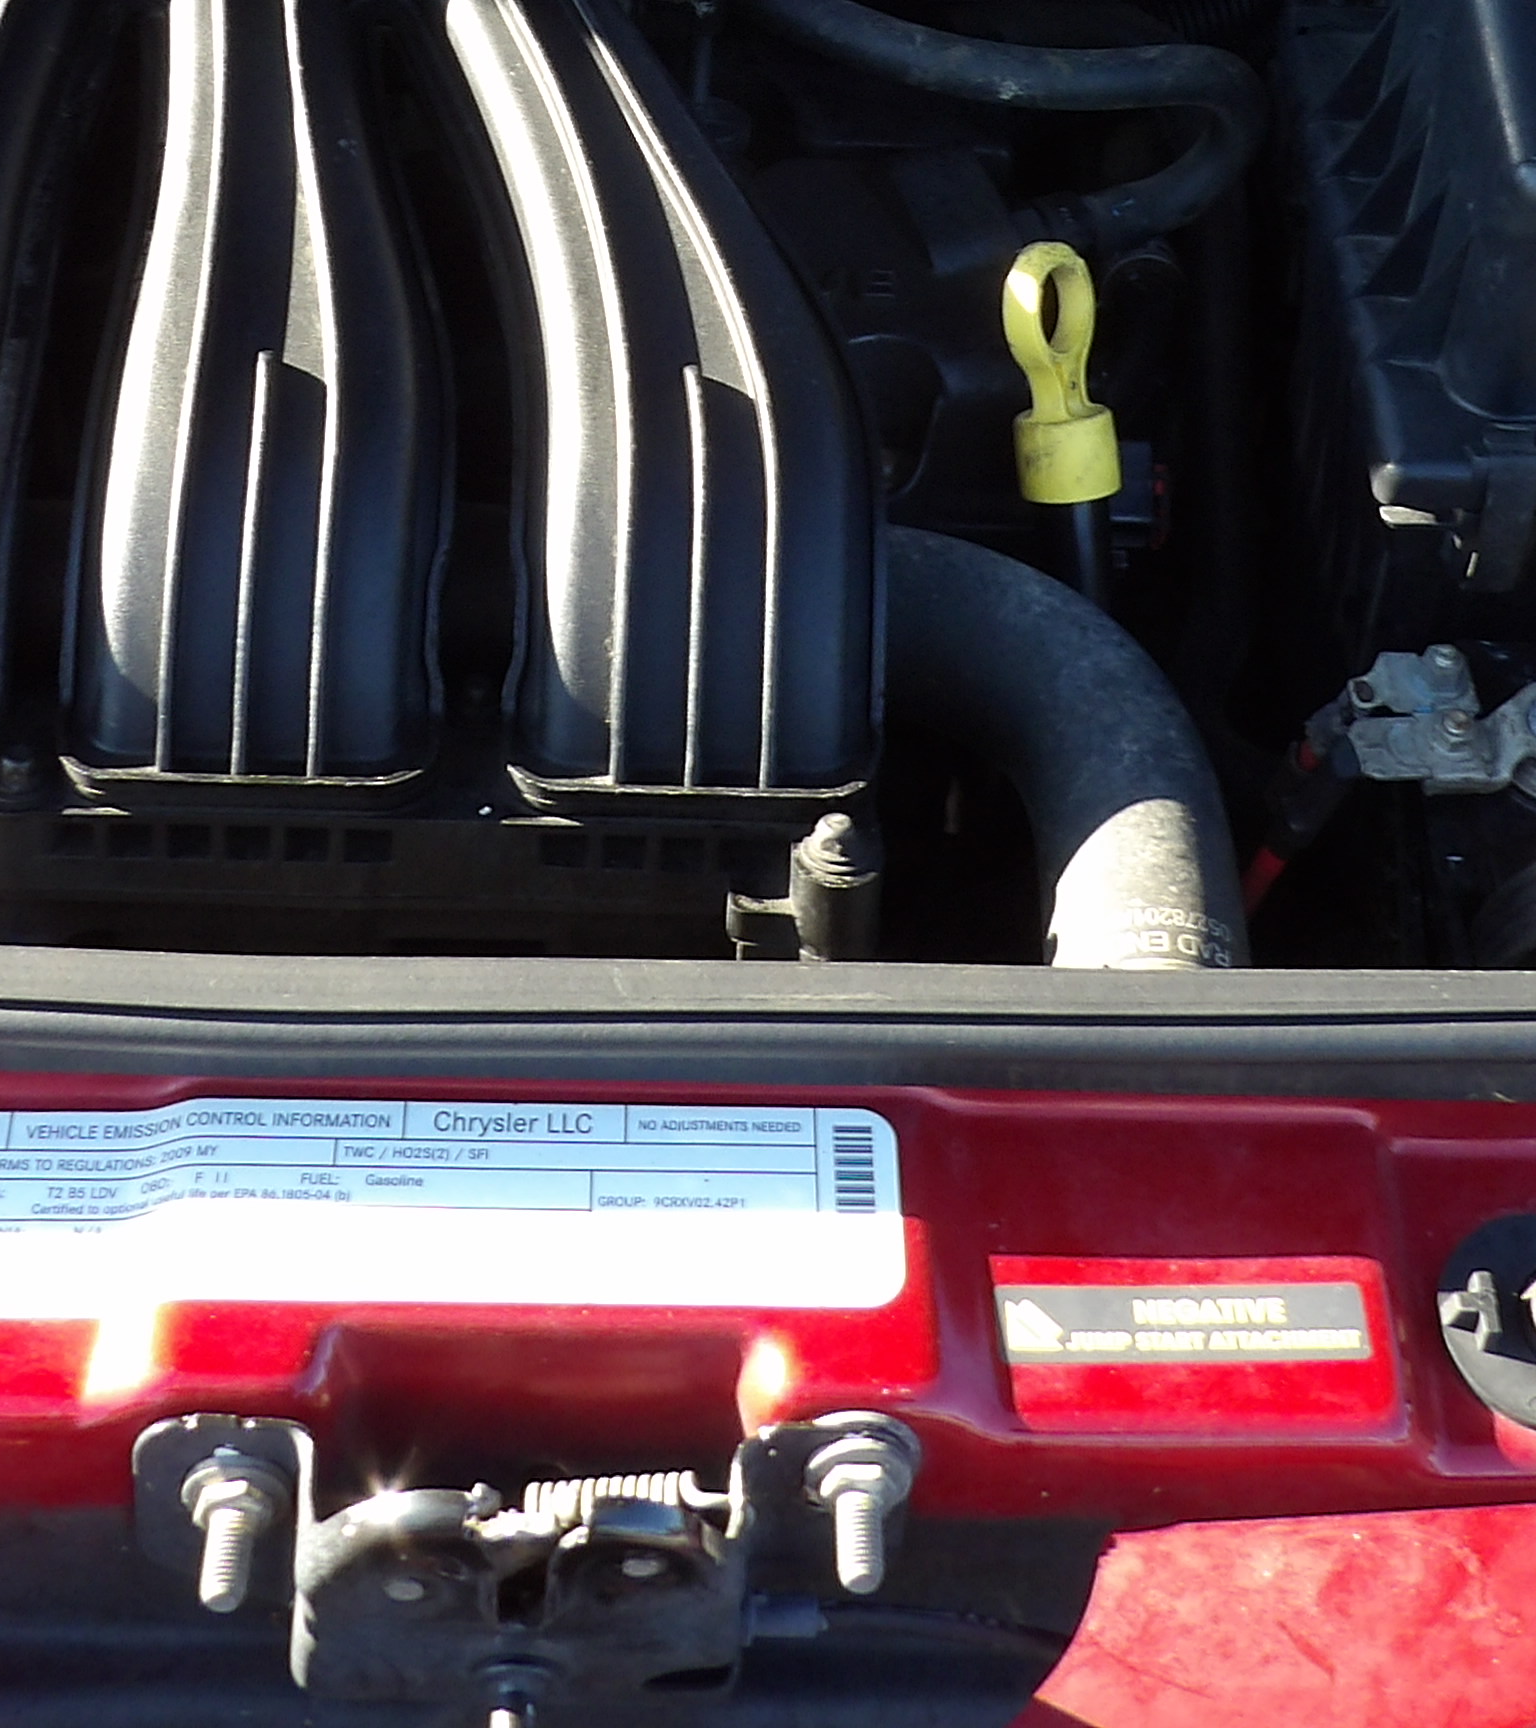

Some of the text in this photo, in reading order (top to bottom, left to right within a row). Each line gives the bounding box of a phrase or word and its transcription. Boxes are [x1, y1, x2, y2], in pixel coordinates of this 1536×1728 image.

[26, 1111, 391, 1140] VEHICLE EMISSION CONTROL INFORMATION
[432, 1110, 593, 1138] Chrysler LLC
[637, 1119, 802, 1133] NO ADJUSTMENTS NEEDED
[35, 1158, 54, 1171] TO
[56, 1154, 157, 1172] REGULATIONS:
[159, 1146, 192, 1164] 2009
[196, 1145, 220, 1157] MY
[343, 1145, 375, 1159] TWC
[194, 1171, 204, 1184] F
[300, 1172, 340, 1186] FUEL:
[364, 1173, 424, 1187] Gasoline
[47, 1186, 64, 1199] T2
[90, 1186, 120, 1200] LDV
[31, 1203, 84, 1216] Certified
[87, 1203, 100, 1215] to
[233, 1186, 258, 1199] EPA
[333, 1189, 352, 1203] (b)
[596, 1196, 646, 1208] GROUP:
[1131, 1296, 1288, 1325] NEGATIVE
[1065, 1328, 1362, 1352] JUMP START ATTACHMENT
